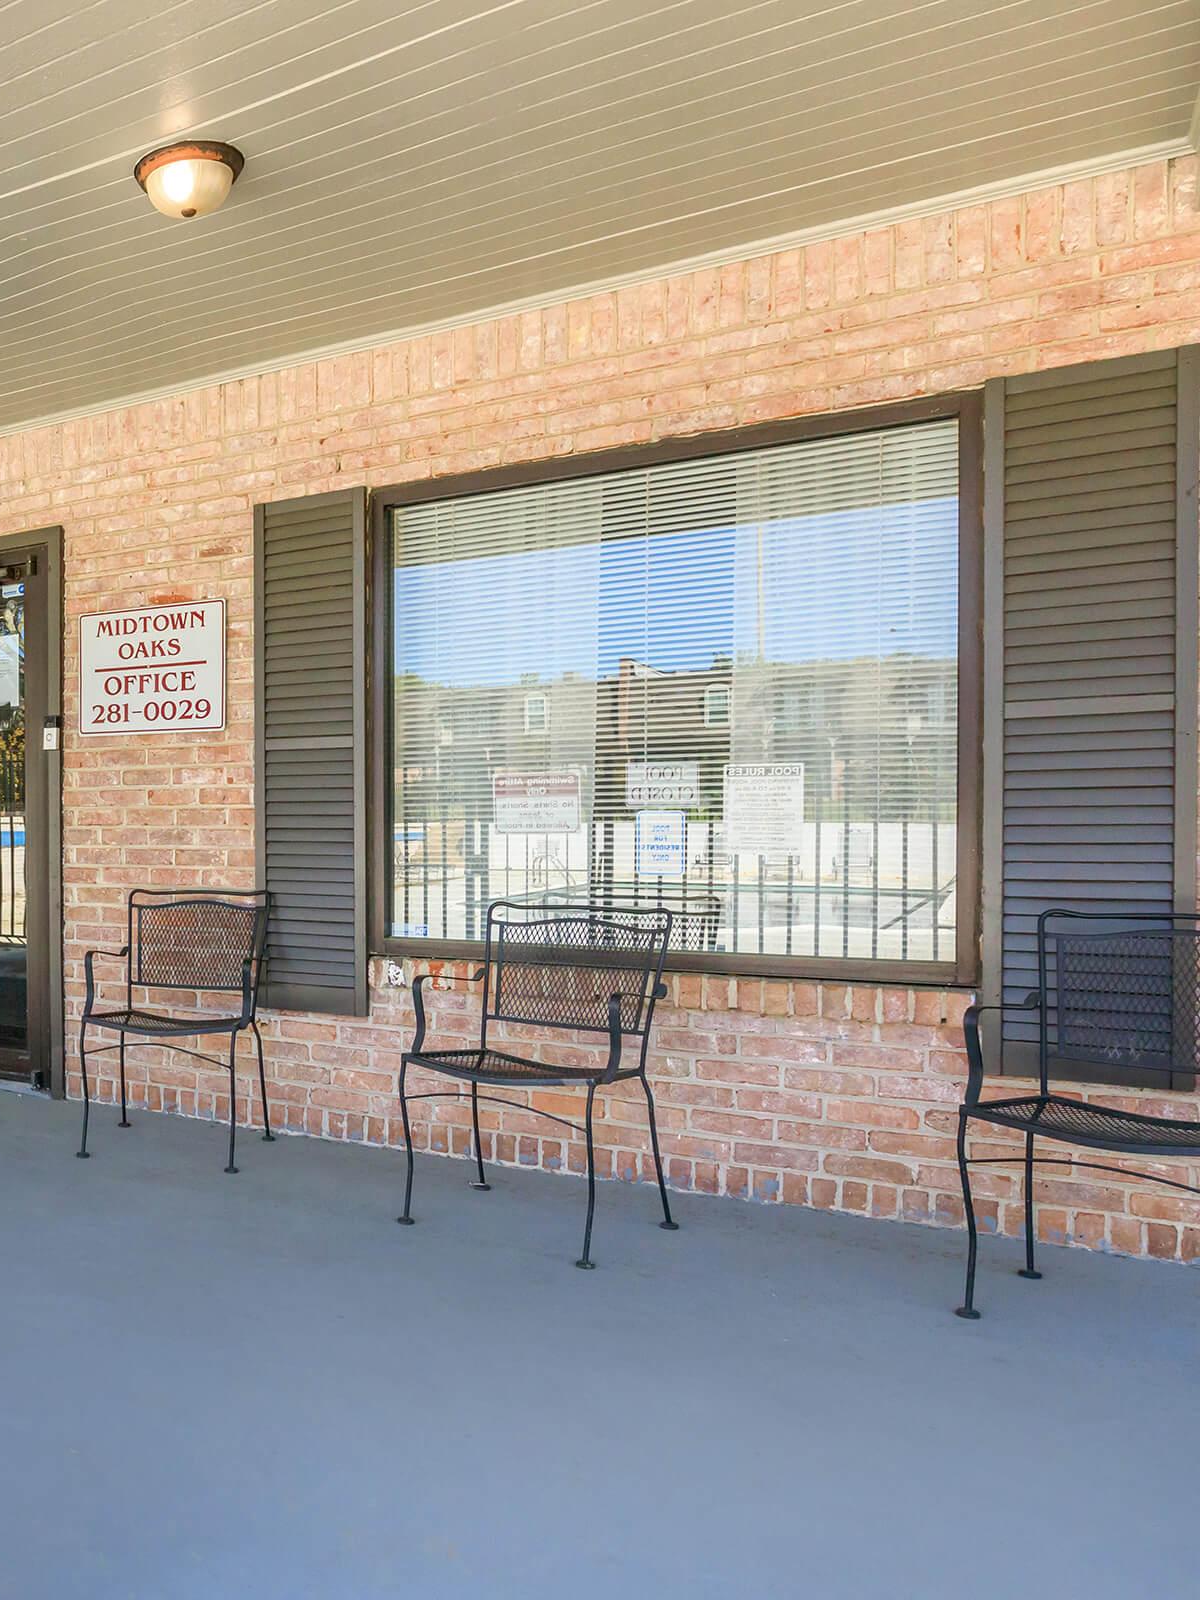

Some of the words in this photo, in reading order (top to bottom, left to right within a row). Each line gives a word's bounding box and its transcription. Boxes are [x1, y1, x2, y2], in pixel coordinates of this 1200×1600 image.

[96, 610, 205, 638] MIDTOWN
[118, 638, 181, 660] OAKS
[104, 671, 196, 696] OFFICE
[91, 699, 211, 724] 281-0029
